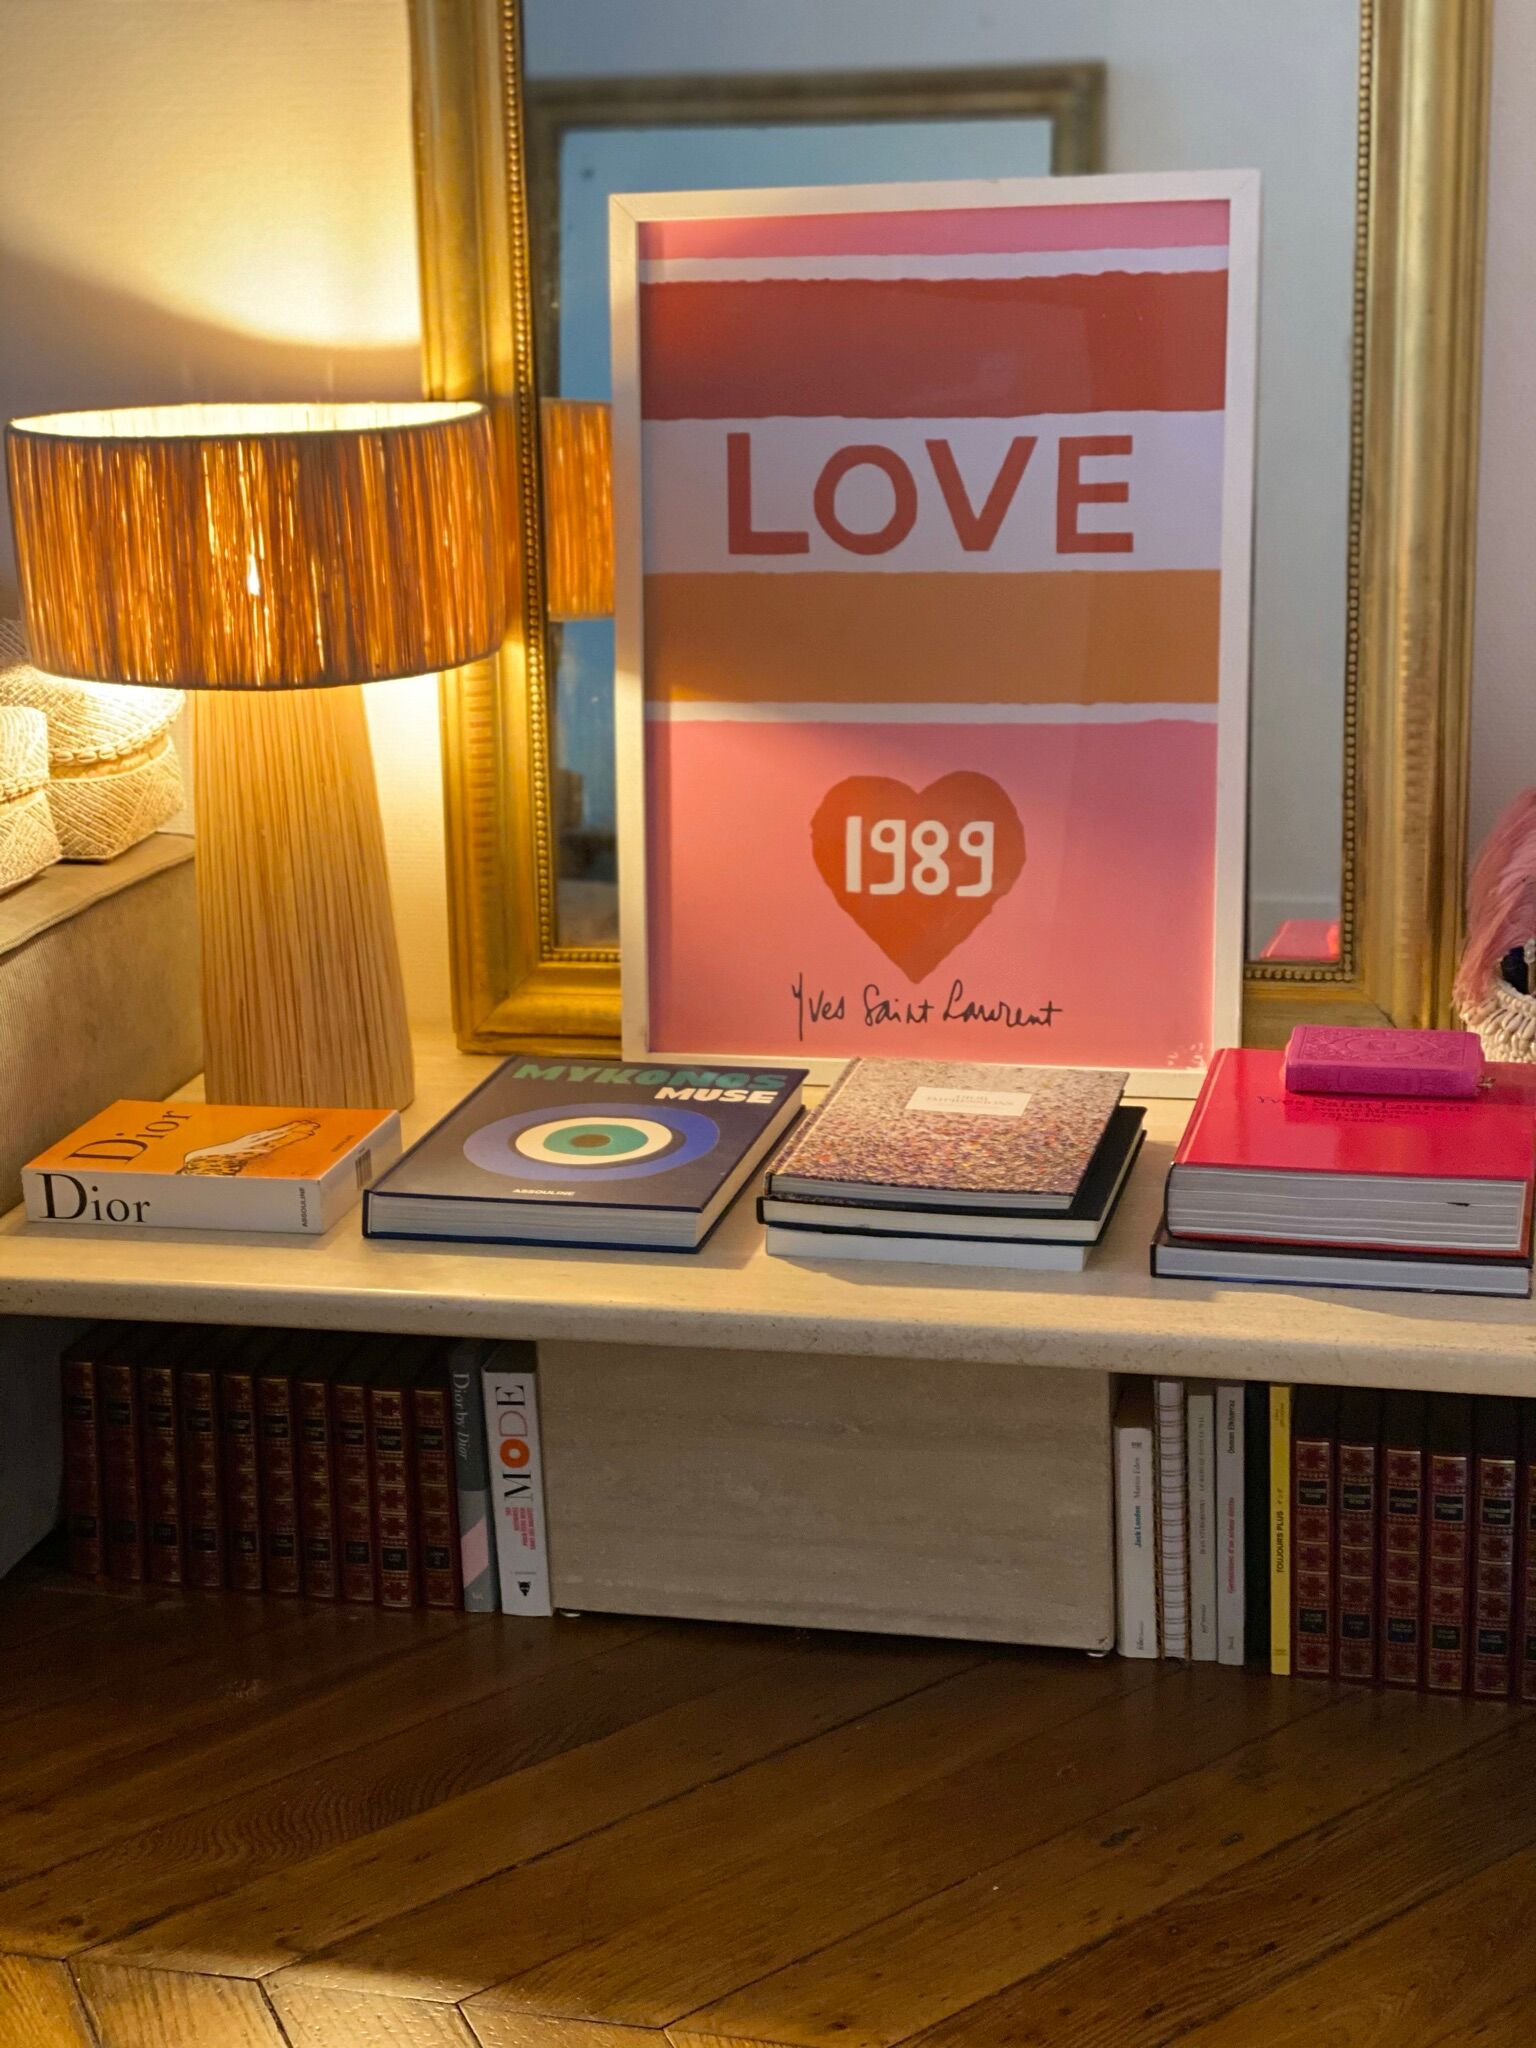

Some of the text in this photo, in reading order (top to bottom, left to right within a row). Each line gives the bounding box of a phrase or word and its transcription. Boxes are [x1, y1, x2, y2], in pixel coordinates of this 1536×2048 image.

[727, 432, 1134, 556] LOVE
[845, 815, 995, 898] 1989
[792, 972, 1063, 1042] Yves Saint Laurent
[511, 1063, 790, 1090] MYKONOS
[654, 1086, 779, 1105] MUSE
[65, 1109, 192, 1164] Dior
[35, 1172, 151, 1224] Dior
[511, 1187, 576, 1197] ASSOULINE
[453, 1373, 471, 1461] Dior by Dior
[495, 1384, 534, 1502] MODE
[1275, 1511, 1285, 1531] PLUS
[1275, 1533, 1285, 1574] TOUJOURS
